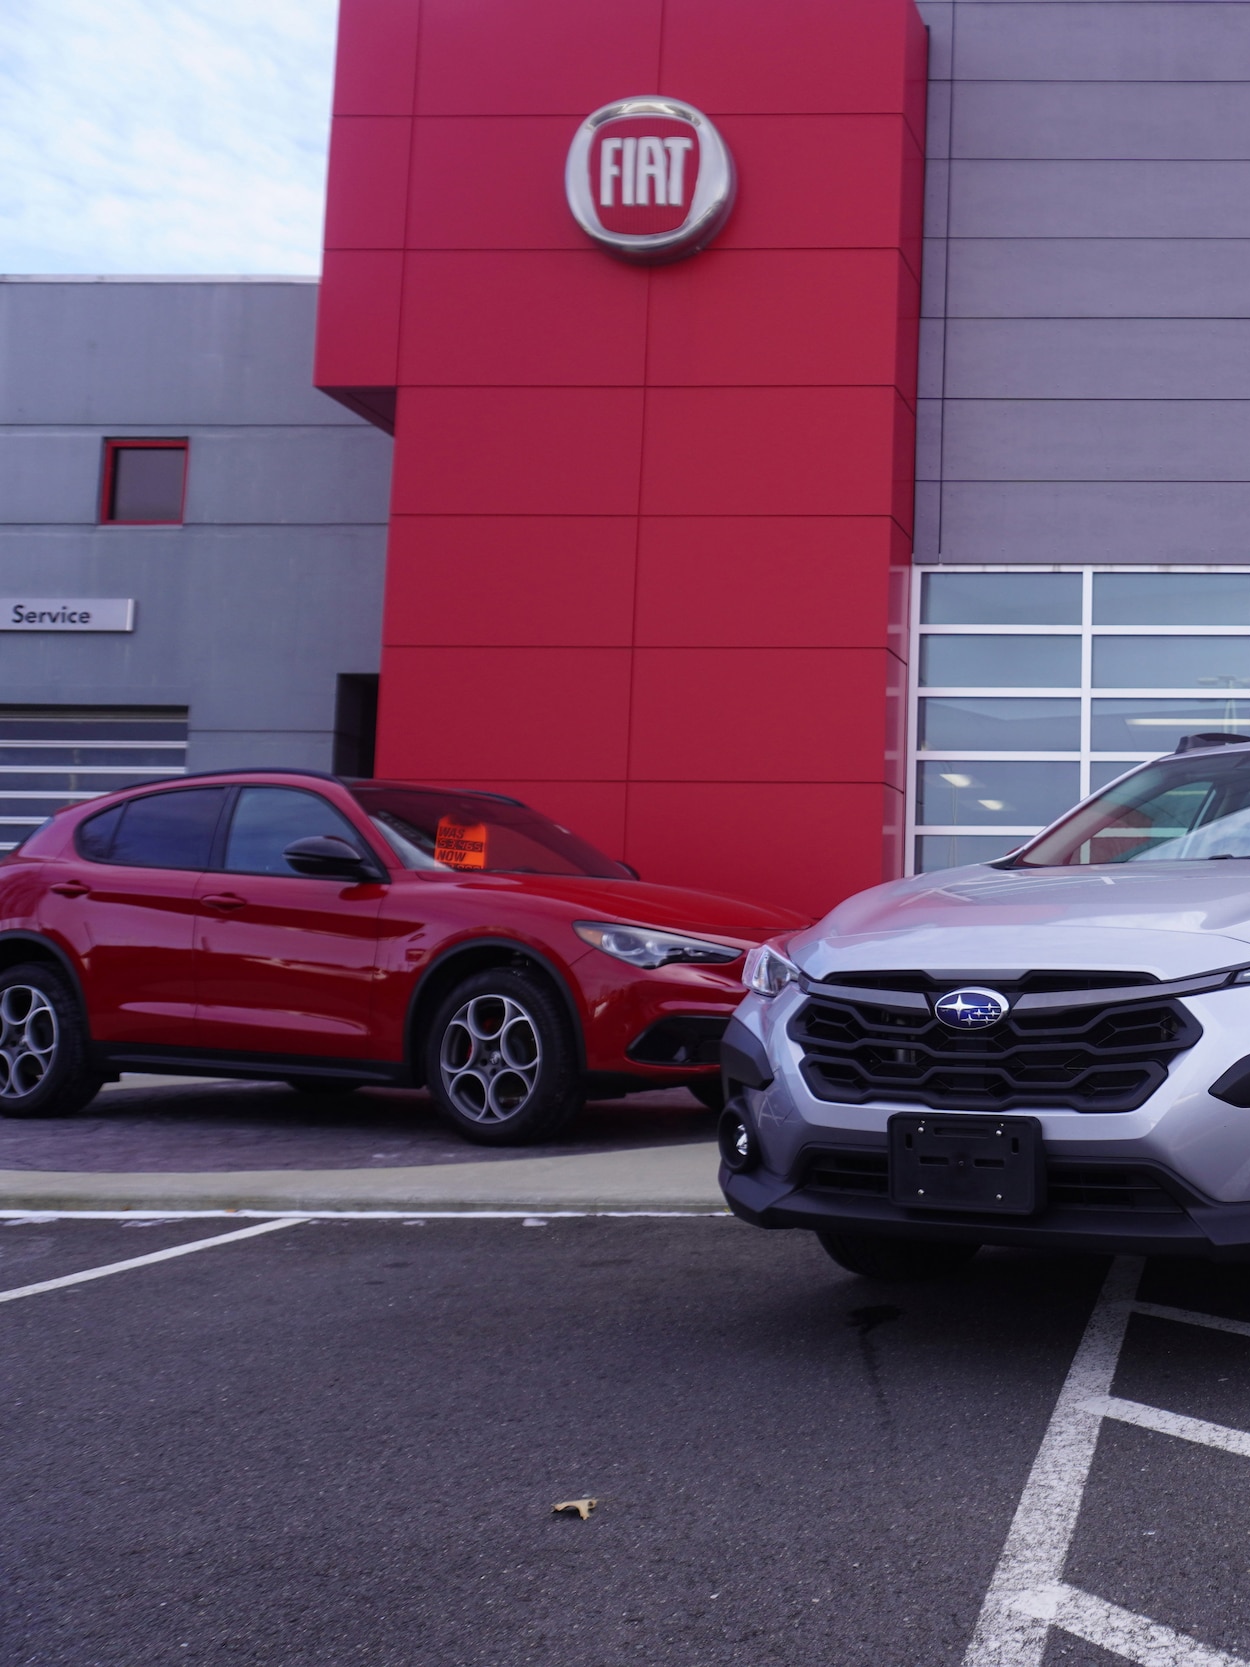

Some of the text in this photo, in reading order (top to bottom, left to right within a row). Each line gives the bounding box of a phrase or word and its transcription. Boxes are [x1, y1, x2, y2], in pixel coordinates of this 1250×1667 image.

[600, 136, 693, 207] FIAT
[11, 604, 91, 624] Service
[439, 826, 465, 838] WAS
[436, 849, 467, 862] NOW
